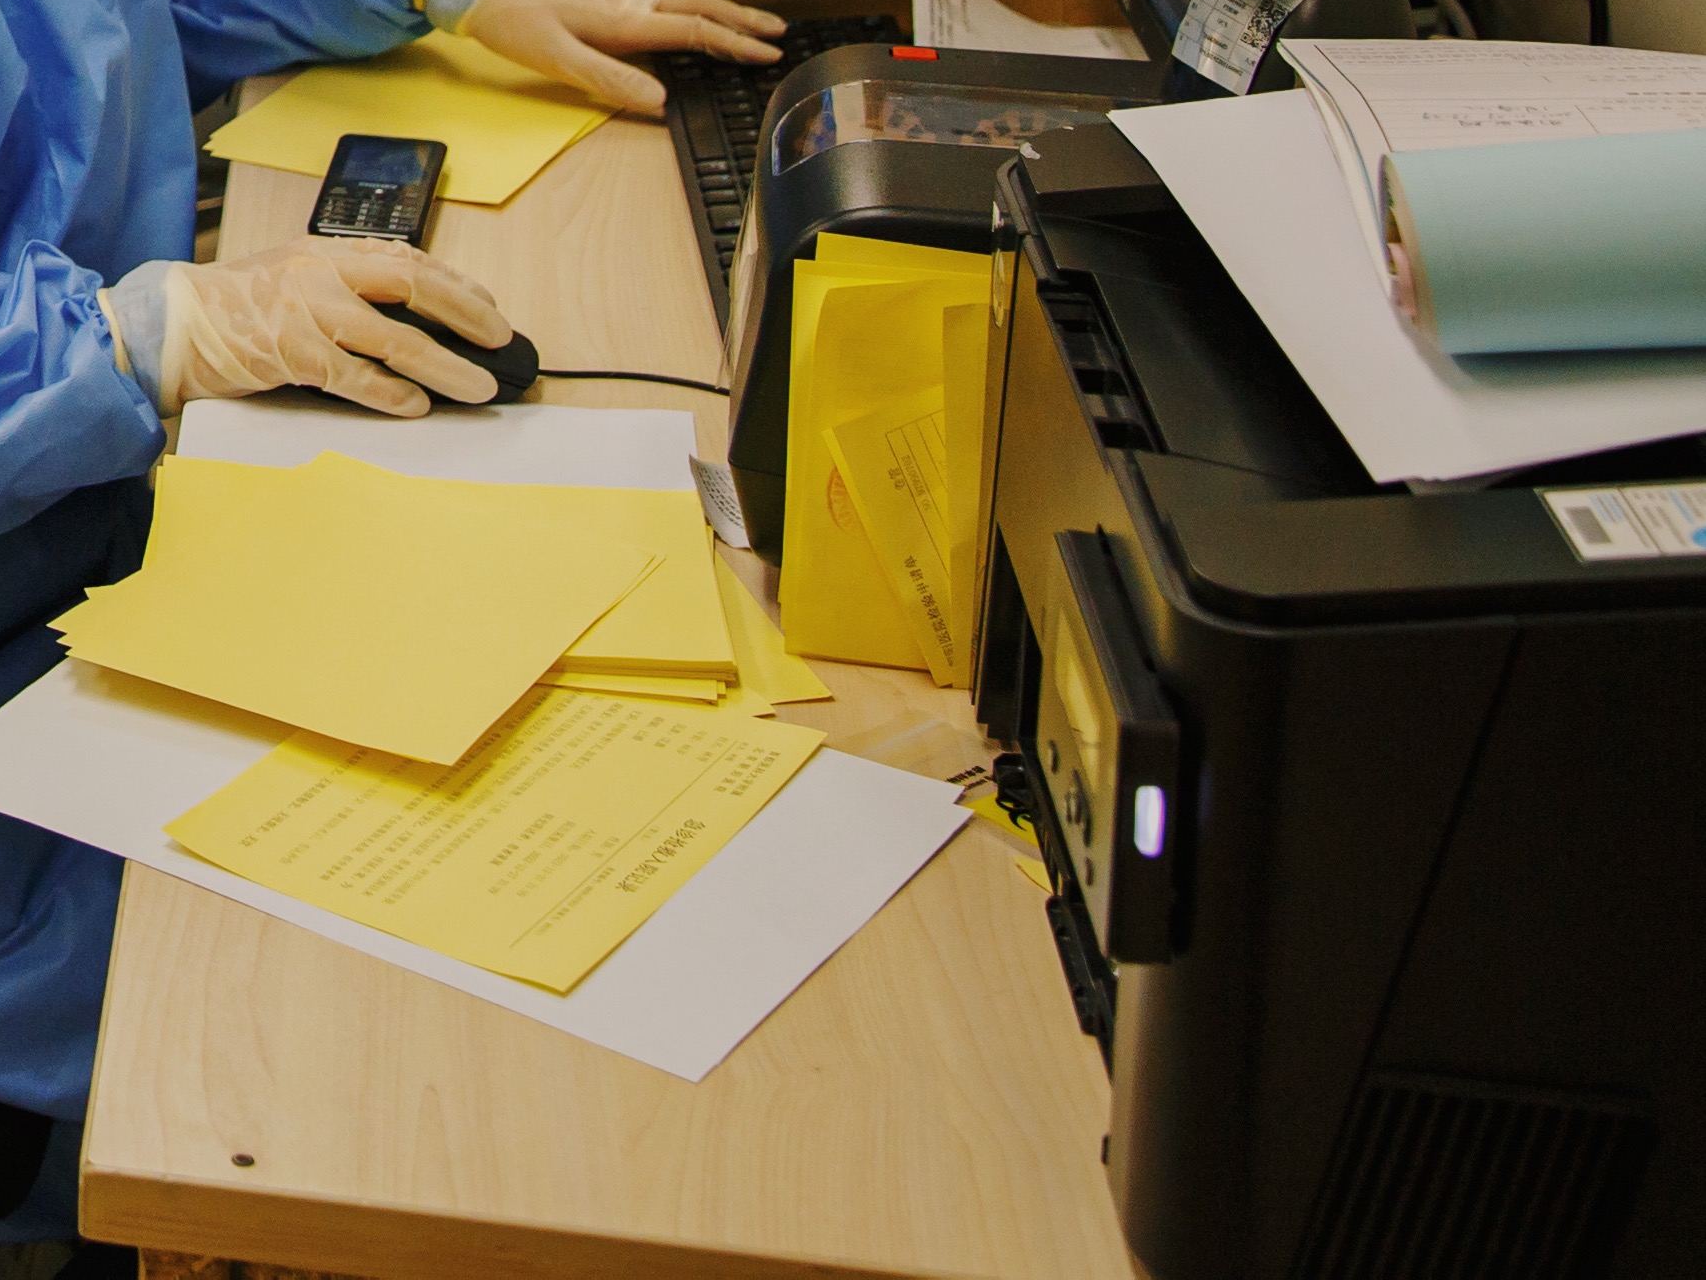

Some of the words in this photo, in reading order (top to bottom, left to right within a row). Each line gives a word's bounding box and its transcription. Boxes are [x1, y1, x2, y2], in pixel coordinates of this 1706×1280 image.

[612, 816, 710, 895] 急诊抢救入院记录
